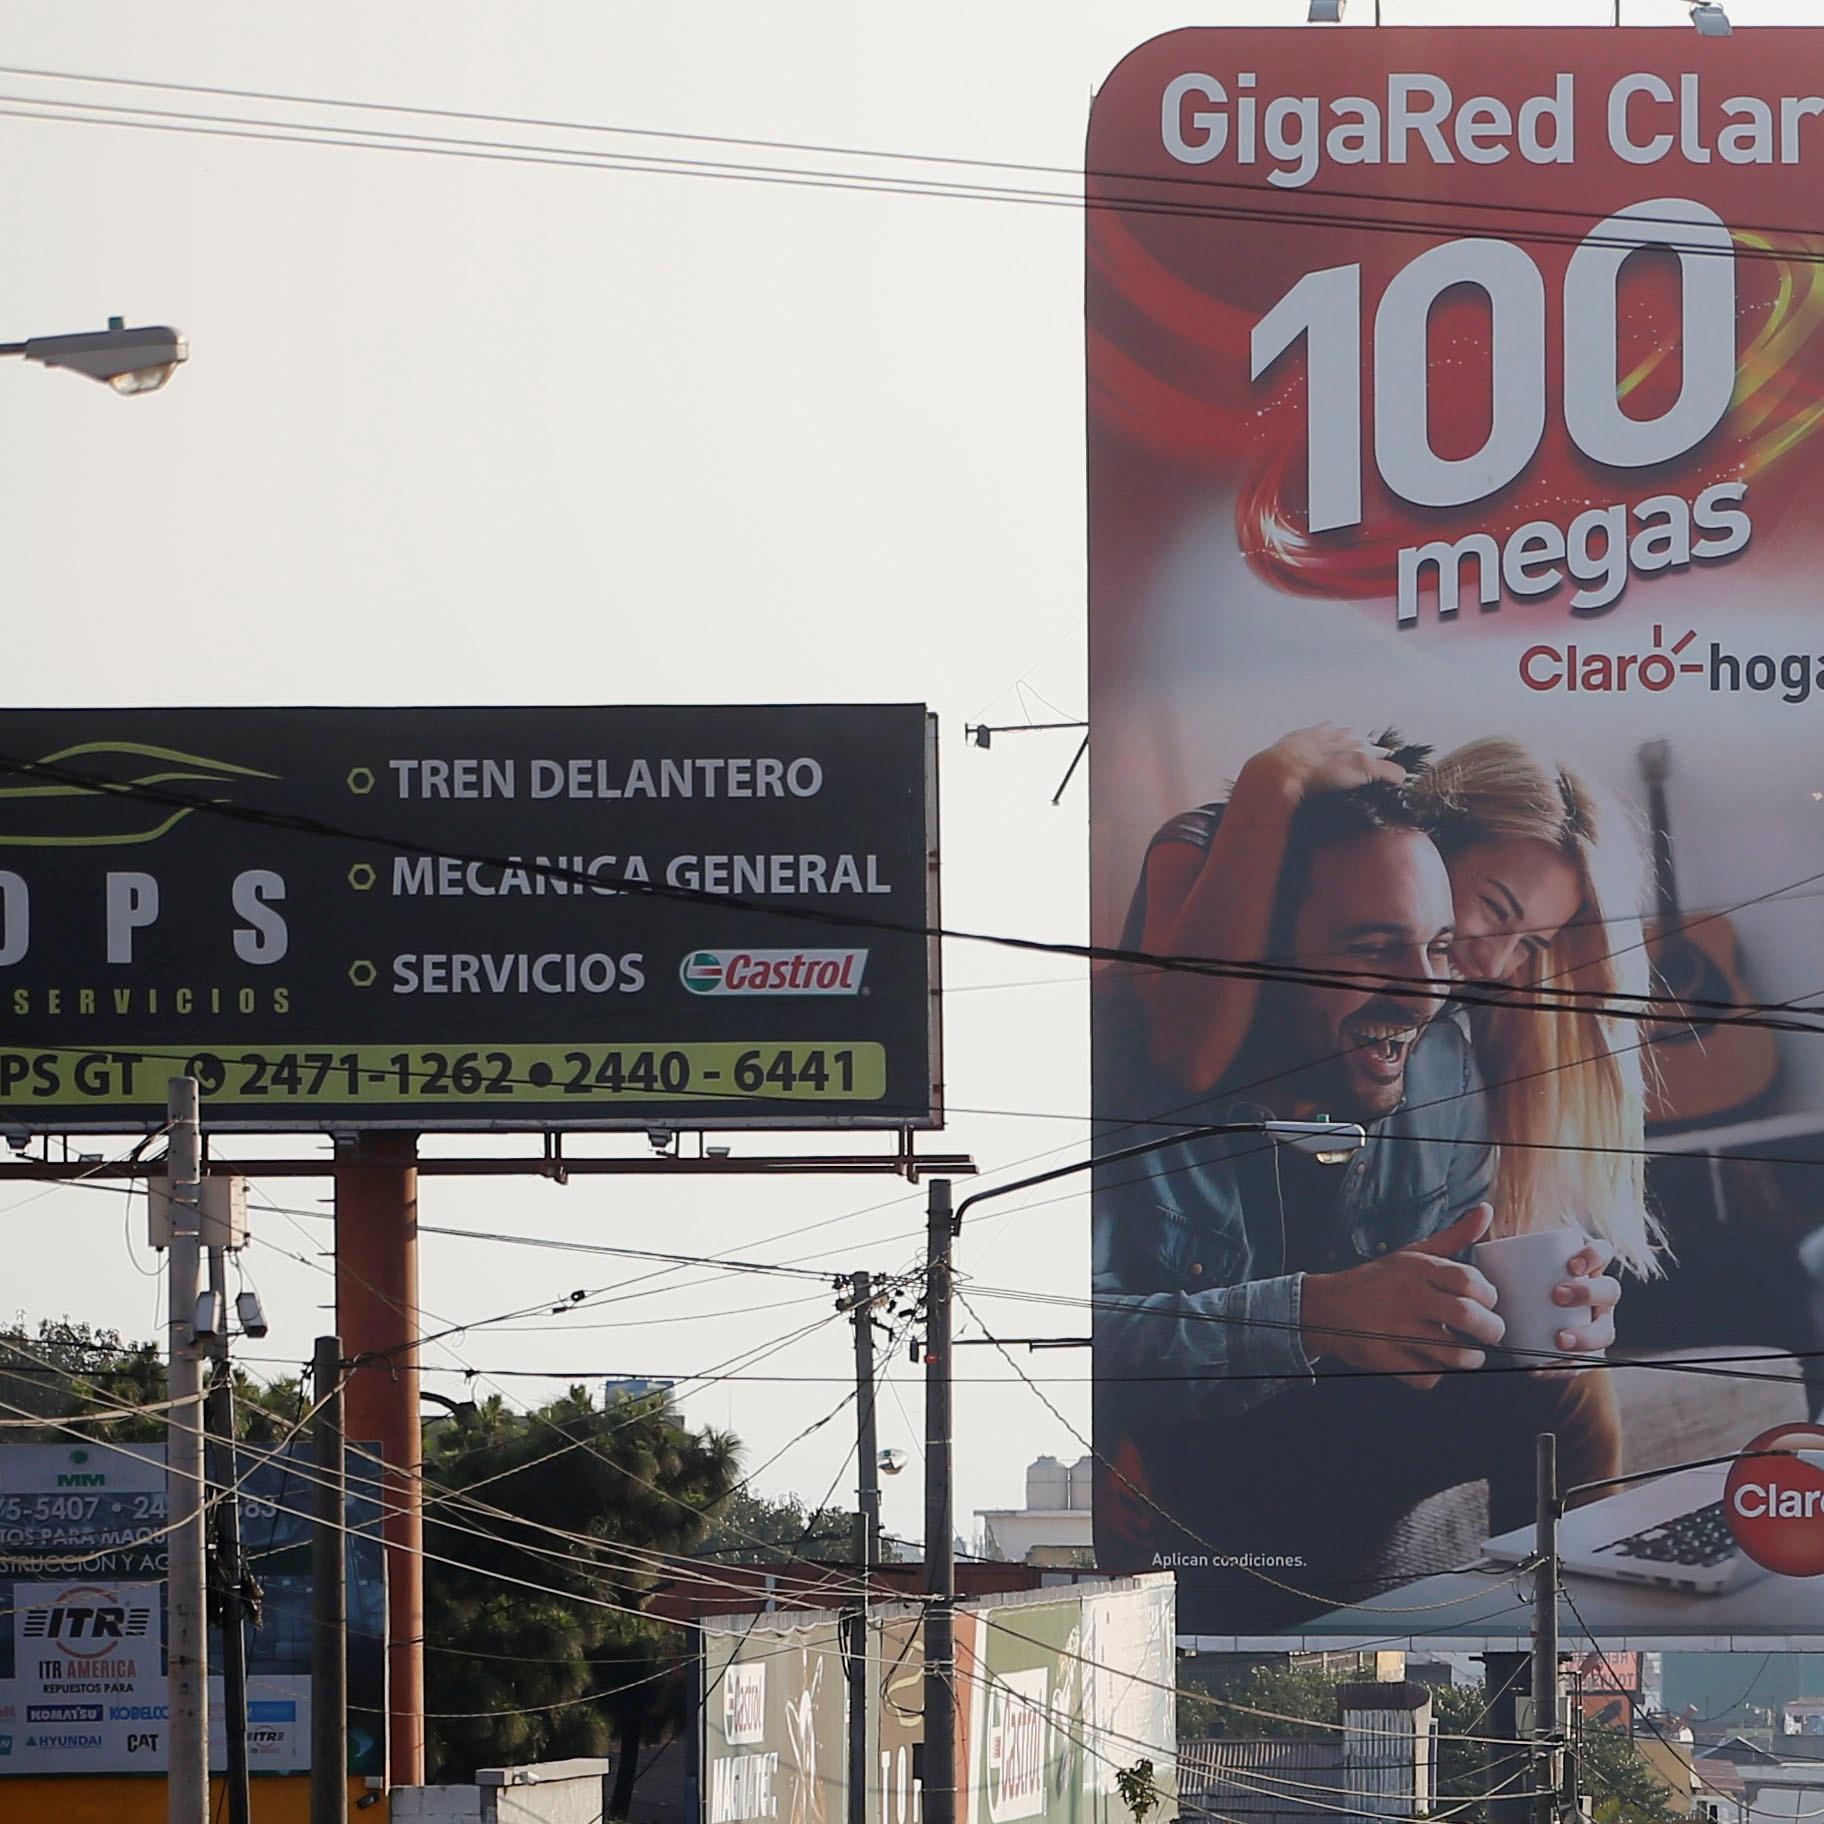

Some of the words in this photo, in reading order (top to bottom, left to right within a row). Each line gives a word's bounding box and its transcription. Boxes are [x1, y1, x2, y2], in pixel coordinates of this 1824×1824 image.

[1161, 72, 1574, 188] GigaRed
[1250, 197, 1736, 534] 100
[1397, 479, 1753, 624] megas
[1518, 643, 1676, 693] Claro
[389, 758, 516, 799] TREN
[530, 757, 824, 799] DELANTERO
[391, 855, 652, 897] MECANICA
[673, 854, 893, 895] GENERAL
[391, 953, 646, 995] SERVICIOS
[725, 952, 855, 992] Castrol
[14, 987, 289, 1015] SERVICIOS
[74, 1054, 143, 1097] GT
[240, 1052, 514, 1097] 2471-1262
[564, 1051, 691, 1094] 2440
[732, 1050, 857, 1093] 6441
[119, 1554, 135, 1571] Y
[1152, 1551, 1208, 1568] Aplican
[1212, 1551, 1307, 1567] condiciones.
[39, 1660, 62, 1679] ITR
[66, 1660, 137, 1680] AMERICA
[43, 1684, 102, 1695] REPUESTOS
[104, 1684, 134, 1694] PARA
[39, 1736, 103, 1747] HYUNDAI
[127, 1733, 159, 1753] CAT
